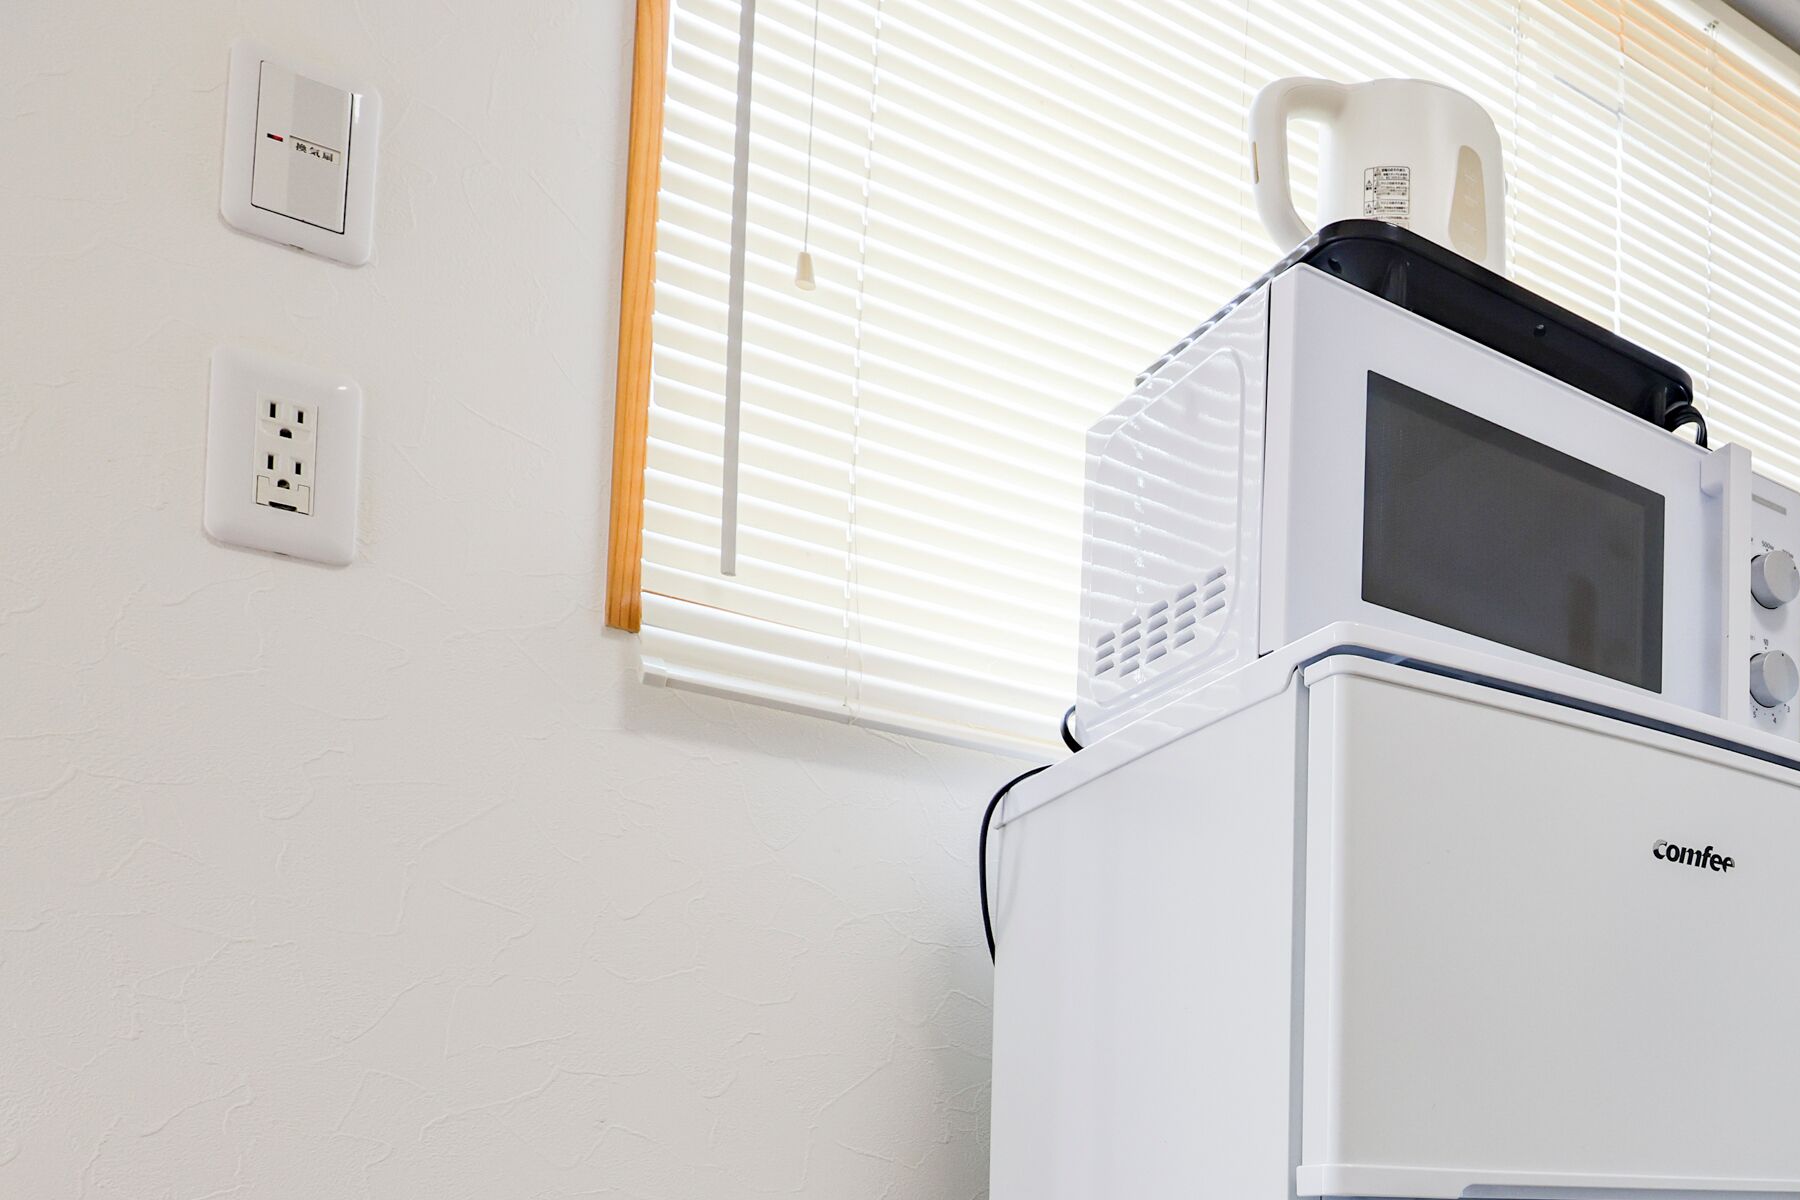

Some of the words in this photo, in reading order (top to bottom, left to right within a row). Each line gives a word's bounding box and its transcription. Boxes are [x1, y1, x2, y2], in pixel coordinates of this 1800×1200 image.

[296, 142, 333, 162] 換気扇
[1653, 838, 1736, 873] comfee
